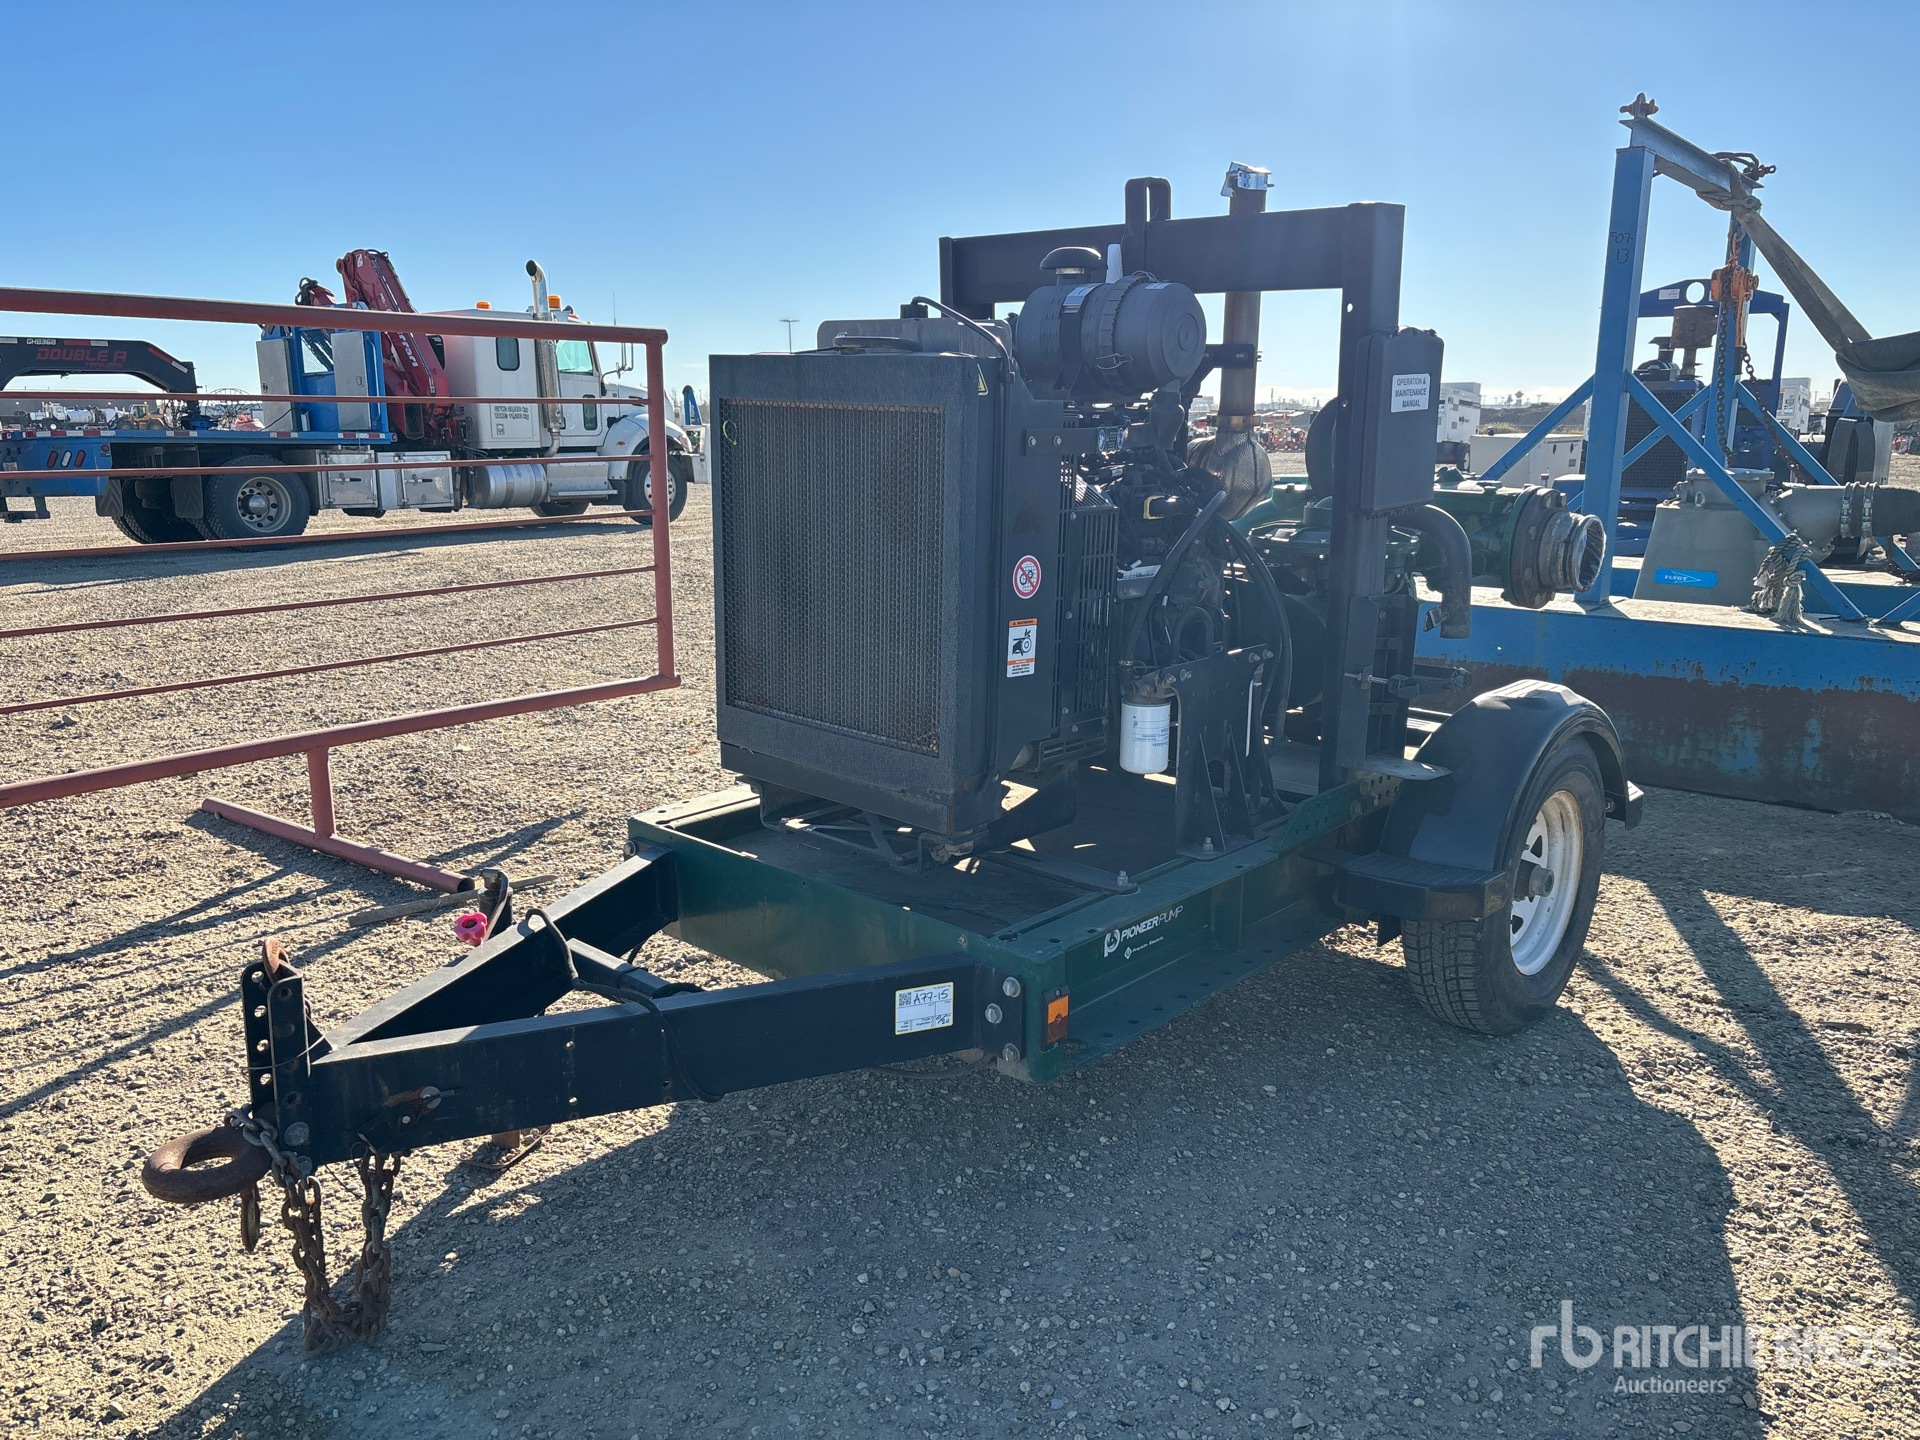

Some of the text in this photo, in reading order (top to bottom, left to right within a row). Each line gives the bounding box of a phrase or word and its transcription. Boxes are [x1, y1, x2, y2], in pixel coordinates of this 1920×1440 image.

[36, 348, 127, 362] DOUBLE A
[1396, 377, 1422, 386] OPERATION
[1395, 388, 1427, 397] MAINTENANCE
[1402, 399, 1421, 408] MANUAL
[913, 989, 950, 1005] A77-15
